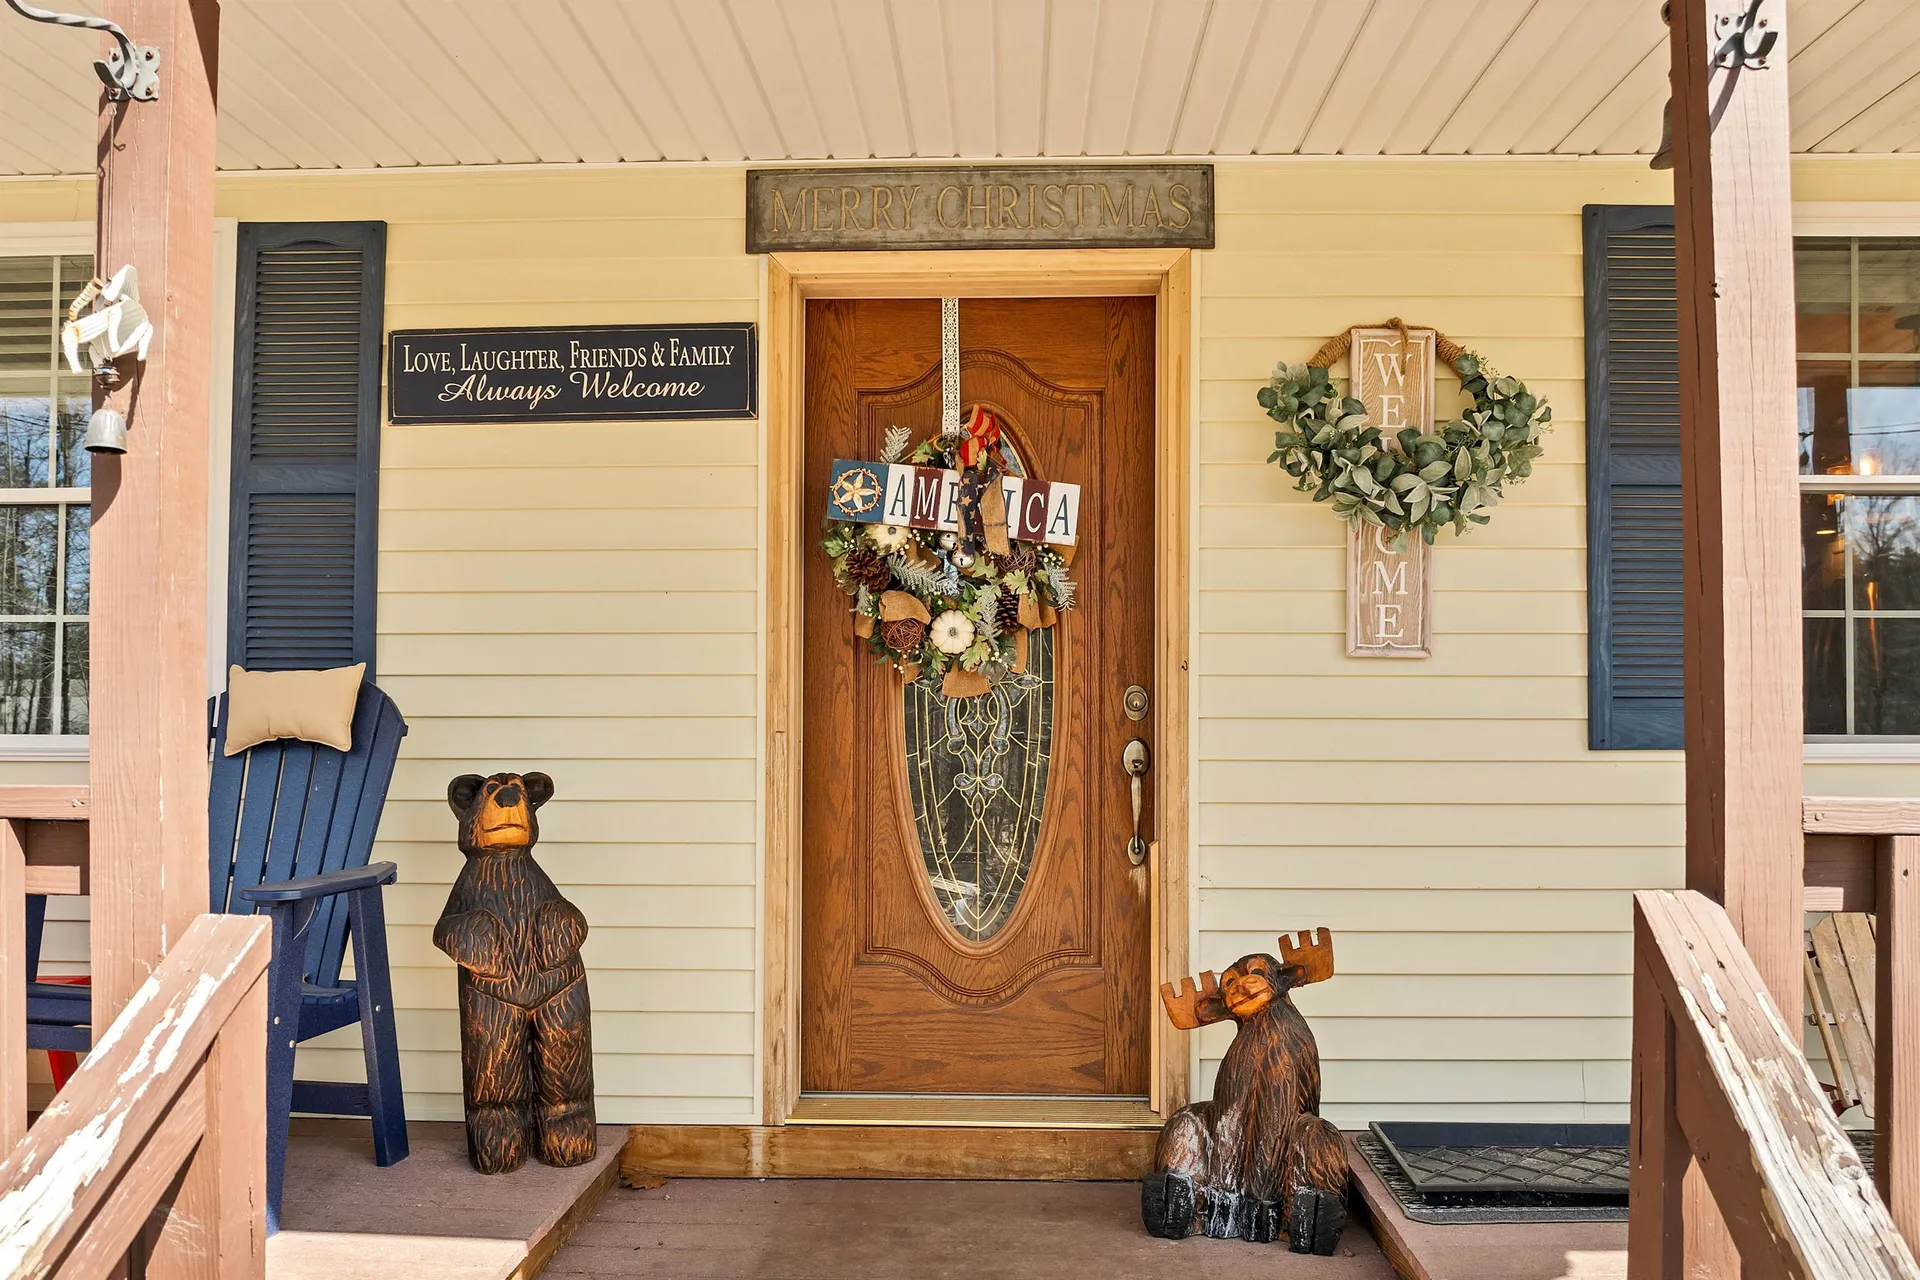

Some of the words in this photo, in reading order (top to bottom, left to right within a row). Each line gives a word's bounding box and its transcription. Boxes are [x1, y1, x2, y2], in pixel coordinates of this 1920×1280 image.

[771, 184, 921, 232] MERRY
[937, 183, 1192, 230] CHRISTMAS
[403, 344, 457, 375] LOVE,
[460, 343, 565, 373] LAUGHTER,
[569, 340, 647, 369] FRIENDS
[651, 341, 665, 367] &
[669, 338, 735, 367] FAMILY
[437, 373, 563, 410] Always
[568, 370, 706, 399] Welcome
[888, 473, 1070, 536] AMEICA
[1371, 353, 1412, 638] WEME
